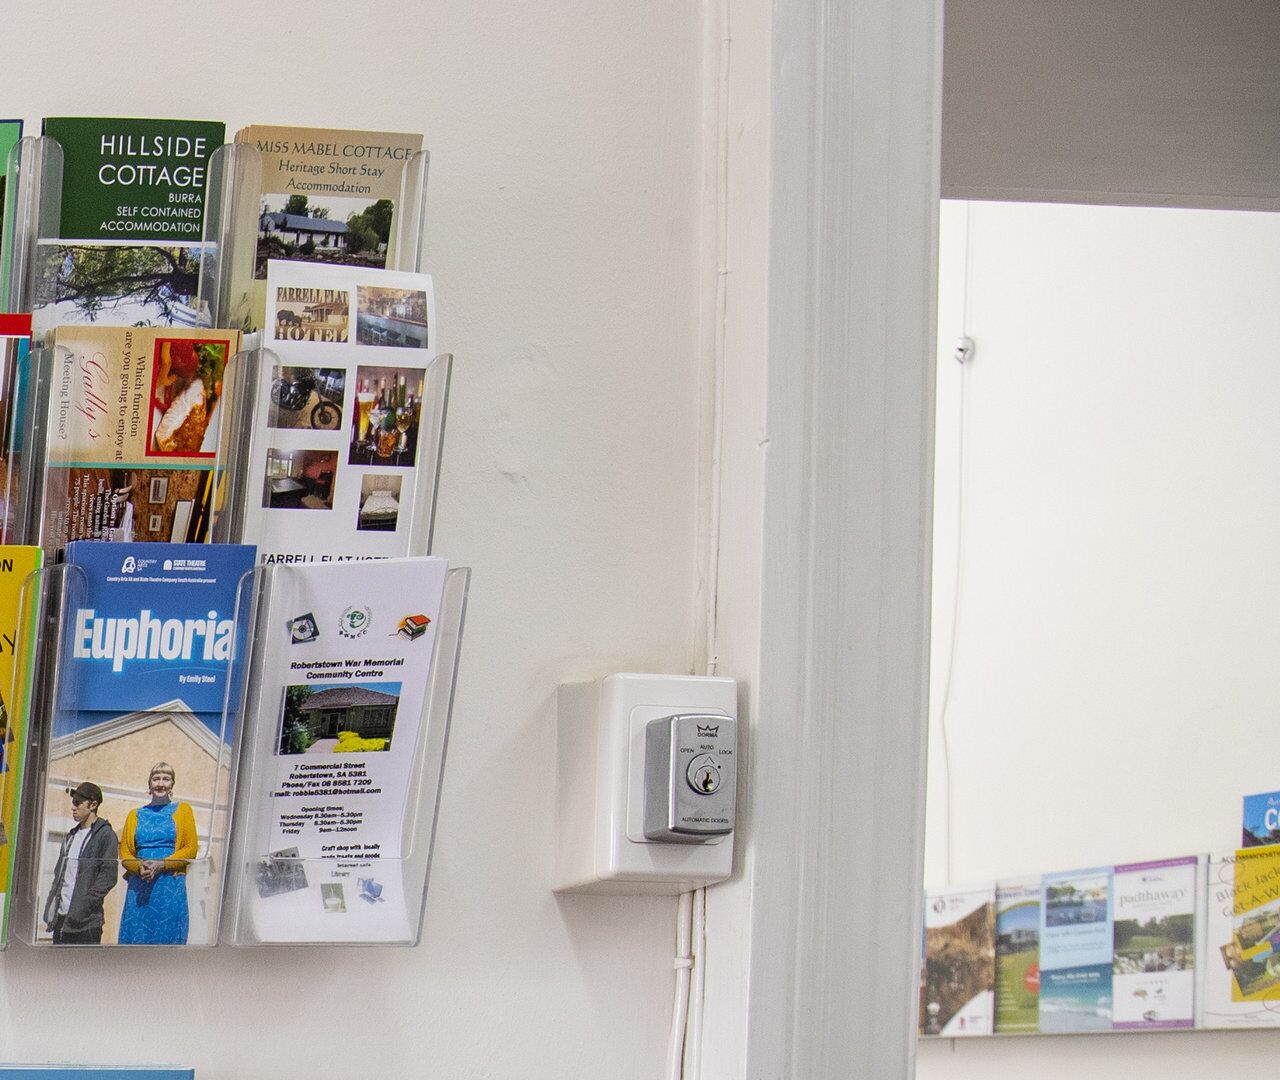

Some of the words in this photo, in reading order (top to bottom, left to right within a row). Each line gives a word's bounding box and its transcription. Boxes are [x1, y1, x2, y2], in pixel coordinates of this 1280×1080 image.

[101, 135, 206, 159] HILLSIDE
[256, 140, 289, 154] MISS
[293, 141, 338, 155] MABEL
[343, 144, 412, 160] COTTAGE
[98, 164, 203, 187] COTTAGE
[73, 608, 236, 672] Euphoria
